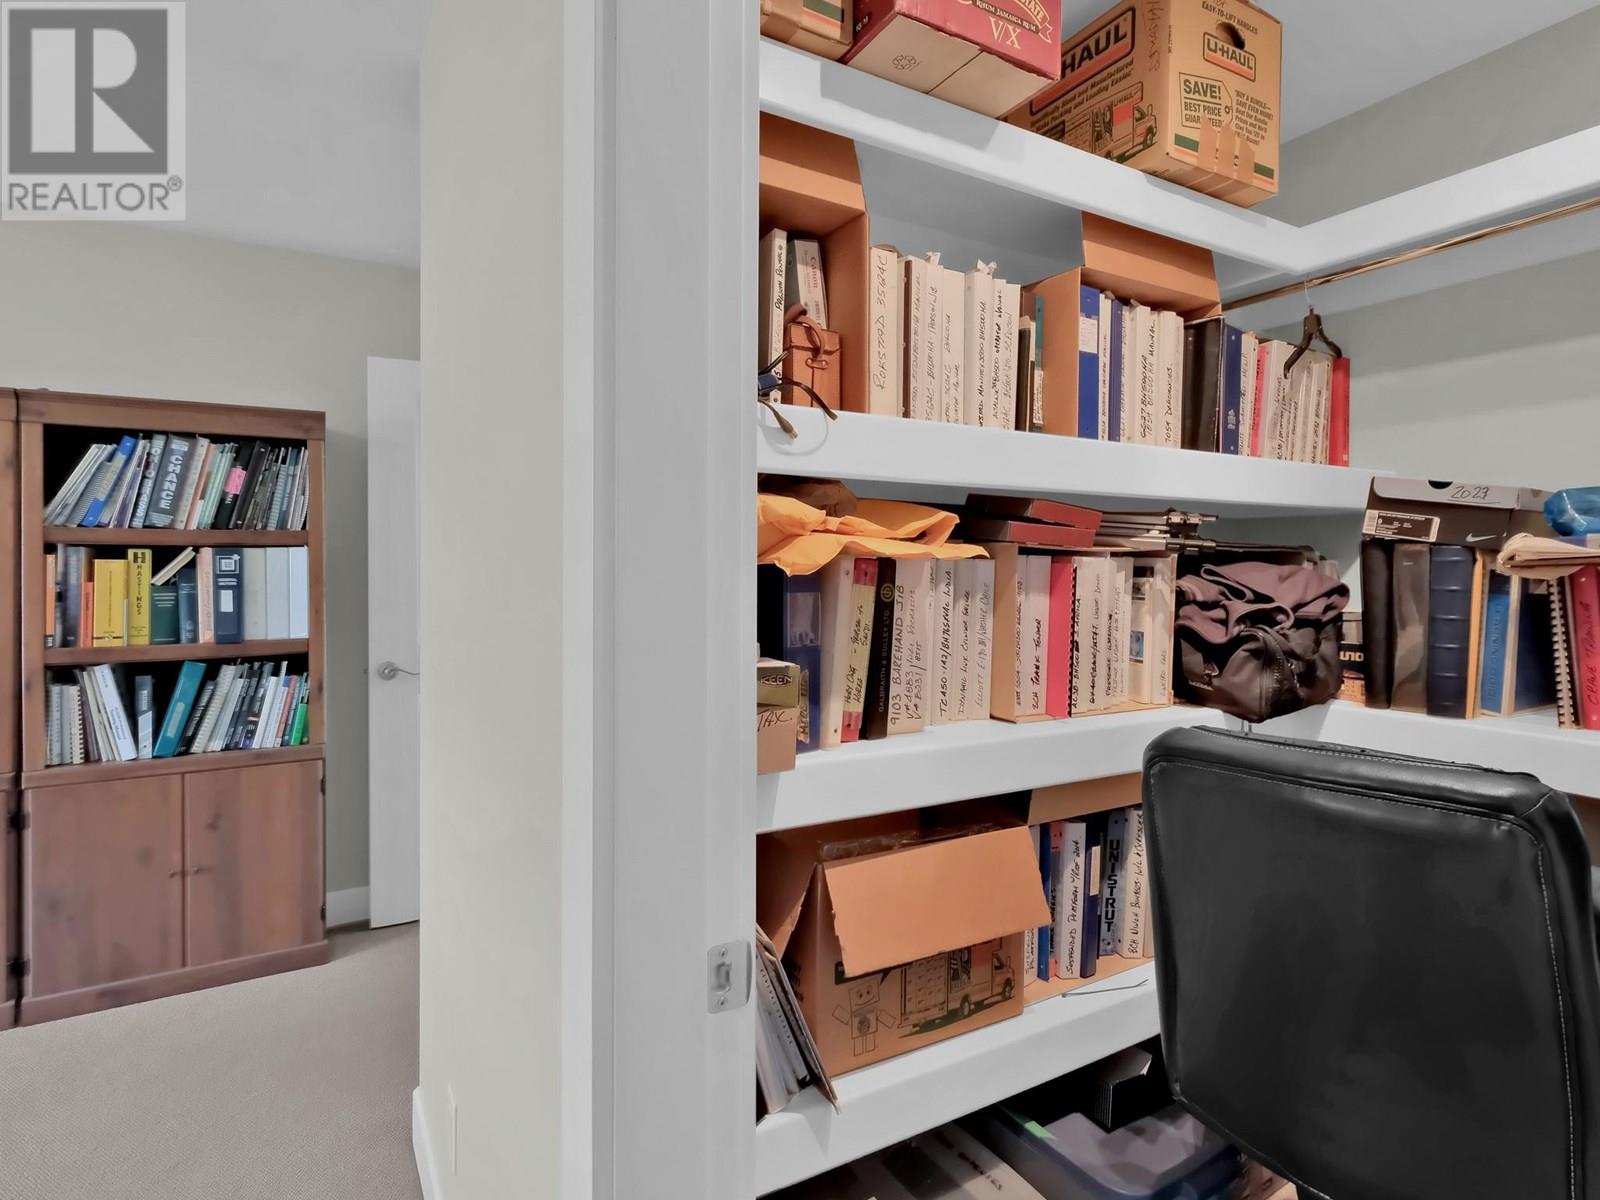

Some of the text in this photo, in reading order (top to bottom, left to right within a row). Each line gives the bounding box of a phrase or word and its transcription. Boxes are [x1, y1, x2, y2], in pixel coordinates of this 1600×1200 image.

[996, 9, 1022, 25] JAMAICA
[1023, 21, 1036, 32] RUM
[1184, 79, 1221, 100] SAVE!
[1184, 101, 1222, 117] BEST PRICE
[810, 256, 818, 289] Canon
[162, 455, 184, 510] CHANGE
[135, 564, 143, 616] HASTINGS
[889, 584, 906, 725] 9103 BAREHAND JIB
[877, 667, 888, 713] GALBRAITH
[1104, 840, 1121, 932] UNISTRUT
